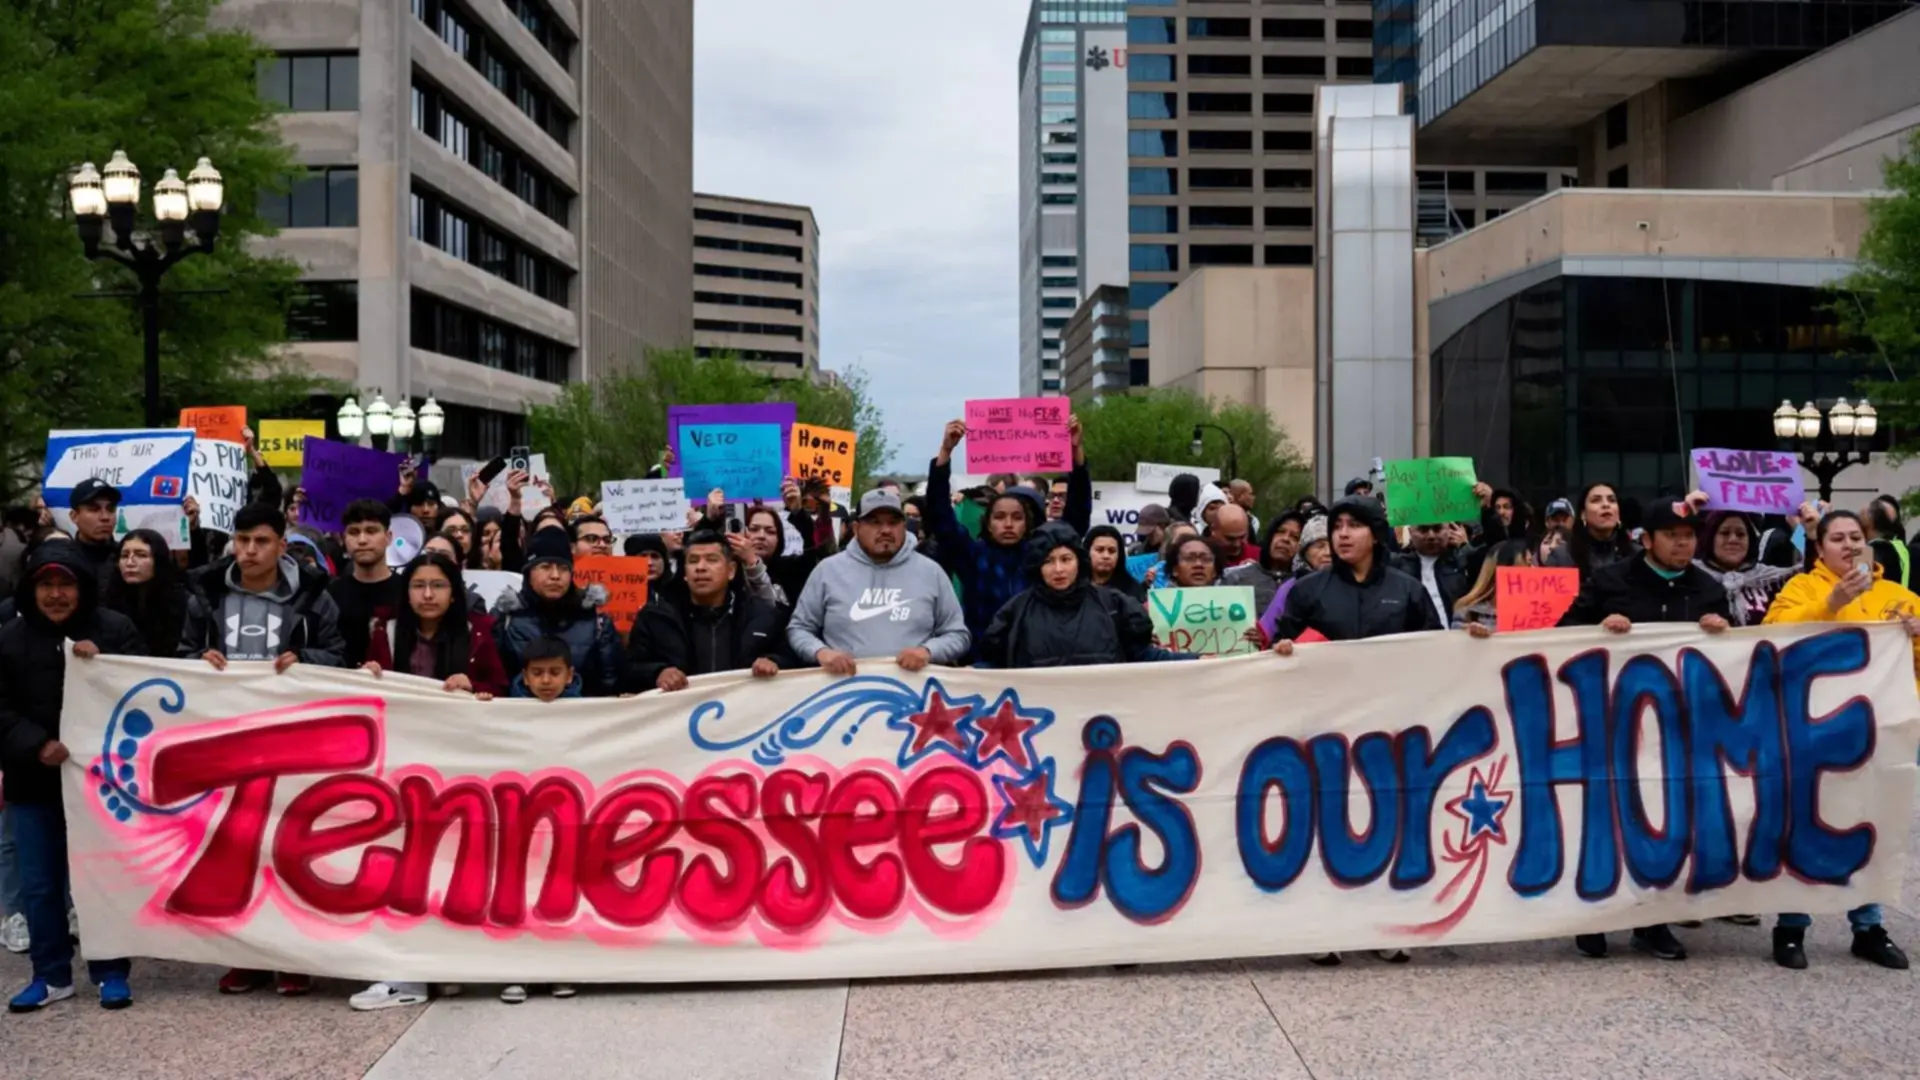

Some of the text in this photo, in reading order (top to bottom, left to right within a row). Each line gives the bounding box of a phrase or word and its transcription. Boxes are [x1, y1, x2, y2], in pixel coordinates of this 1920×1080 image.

[988, 406, 1013, 419] HATE
[1034, 406, 1061, 420] FEAR
[690, 430, 738, 448] VETO
[798, 428, 849, 455] Home
[967, 429, 1051, 442] IMMIGRANTS
[71, 443, 154, 460] THIS IS OUR
[260, 438, 281, 451] IS
[813, 452, 824, 467] is
[1034, 451, 1064, 465] HERE
[1708, 451, 1780, 475] LOVE
[1719, 481, 1791, 508] FEAR
[1505, 572, 1571, 596] HOME
[860, 588, 902, 605] NIKE
[889, 606, 911, 622] SB
[1149, 590, 1247, 628] Veto
[1530, 600, 1553, 616] IS
[152, 627, 1877, 932] Tennessee is our HOME
